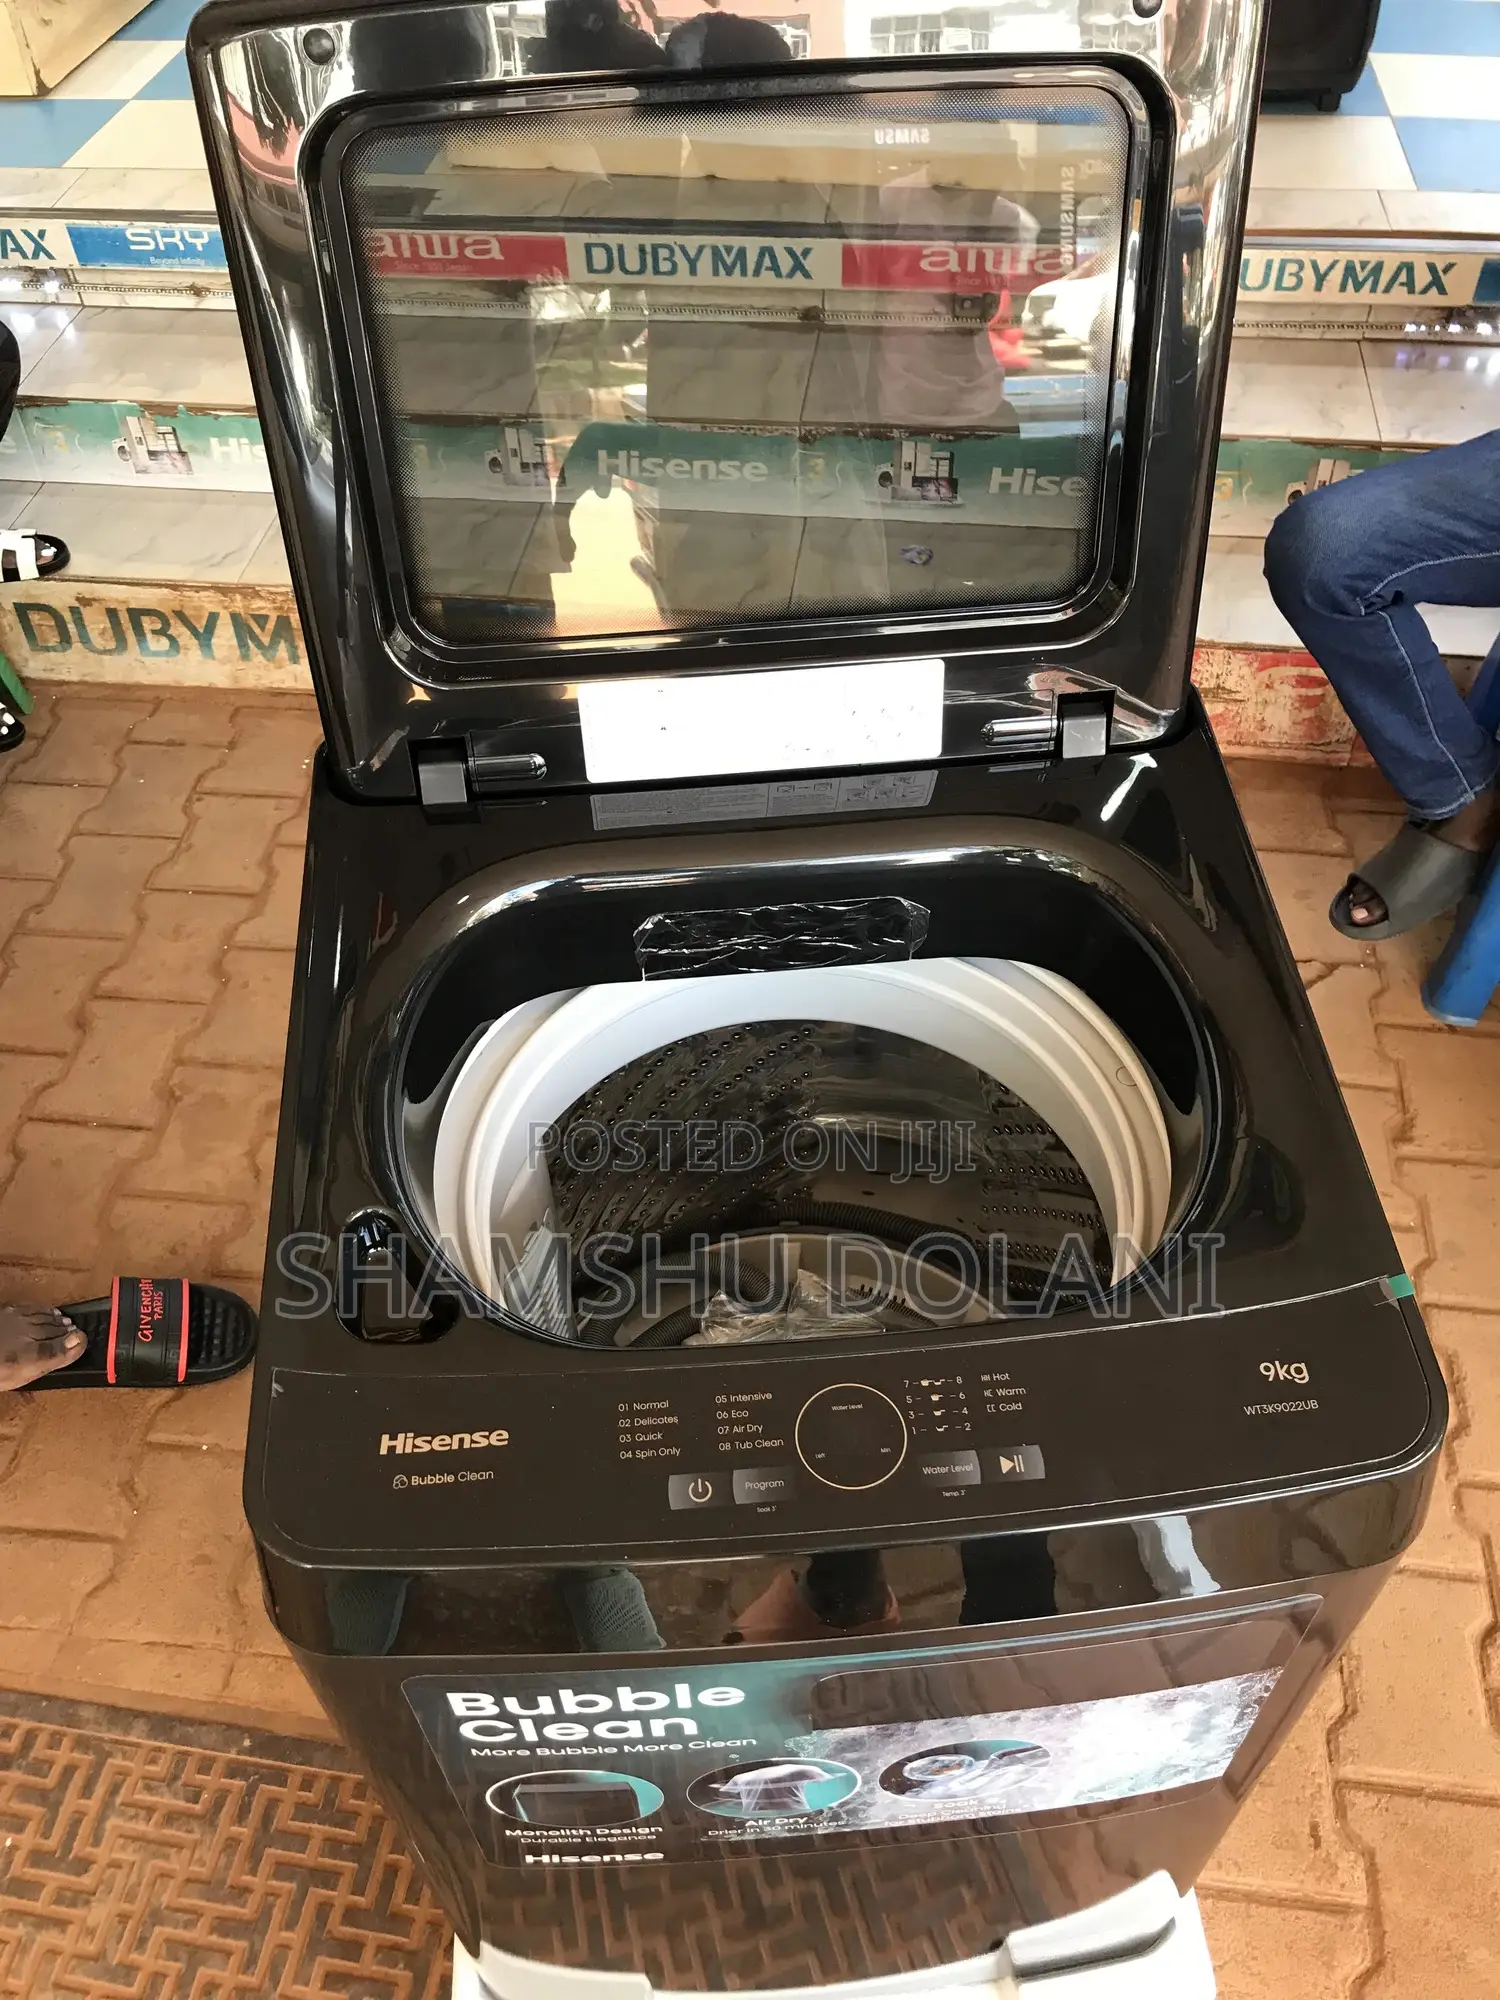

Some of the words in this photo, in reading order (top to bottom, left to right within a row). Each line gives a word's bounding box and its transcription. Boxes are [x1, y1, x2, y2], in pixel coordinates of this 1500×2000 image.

[583, 242, 814, 280] DUBYMAX
[1238, 257, 1458, 295] UBYMAX
[598, 448, 769, 482] Hisense
[13, 602, 301, 665] DUBYM
[153, 1291, 164, 1320] PARIS
[992, 1372, 1011, 1381] Hot
[1259, 1360, 1309, 1384] 9kg
[956, 1376, 963, 1385] 8
[715, 1394, 728, 1404] 05
[730, 1391, 773, 1403] Intensive
[959, 1391, 966, 1400] 6
[995, 1387, 1027, 1396] Warm
[618, 1403, 629, 1412] 01
[633, 1399, 669, 1411] Normal
[961, 1406, 969, 1415] 4
[999, 1402, 1023, 1412] Cold
[1243, 1399, 1319, 1416] WT3K9022UB
[716, 1410, 729, 1420] 06
[731, 1409, 749, 1418] Eco
[618, 1418, 631, 1428] 02
[634, 1415, 679, 1427] Delicates
[964, 1422, 972, 1431] 2
[717, 1425, 730, 1435] 07
[732, 1424, 745, 1434] Air
[746, 1423, 763, 1434] Dry
[379, 1429, 510, 1456] Hisense
[619, 1434, 632, 1443] 03
[635, 1431, 663, 1442] Quick
[718, 1442, 731, 1451] 08
[734, 1440, 753, 1450] Tub
[754, 1438, 784, 1448] Clean
[619, 1450, 633, 1460] 04
[635, 1448, 657, 1460] Spin
[658, 1446, 681, 1457] Only
[922, 1466, 949, 1475] Water
[950, 1462, 974, 1473] Level
[411, 1472, 455, 1486] Bubble
[457, 1470, 494, 1482] Clean
[744, 1480, 785, 1491] Program
[446, 1683, 746, 1717] Bubble
[459, 1716, 698, 1742] Clean
[470, 1748, 530, 1757] More
[535, 1746, 618, 1756] Bubble
[623, 1743, 683, 1753] More
[688, 1738, 757, 1749] Clean
[774, 1816, 809, 1824] Dry
[505, 1828, 592, 1837] Monolith
[596, 1826, 664, 1835] Design
[585, 1834, 657, 1842] Elegance
[525, 1852, 665, 1864] Hisense
